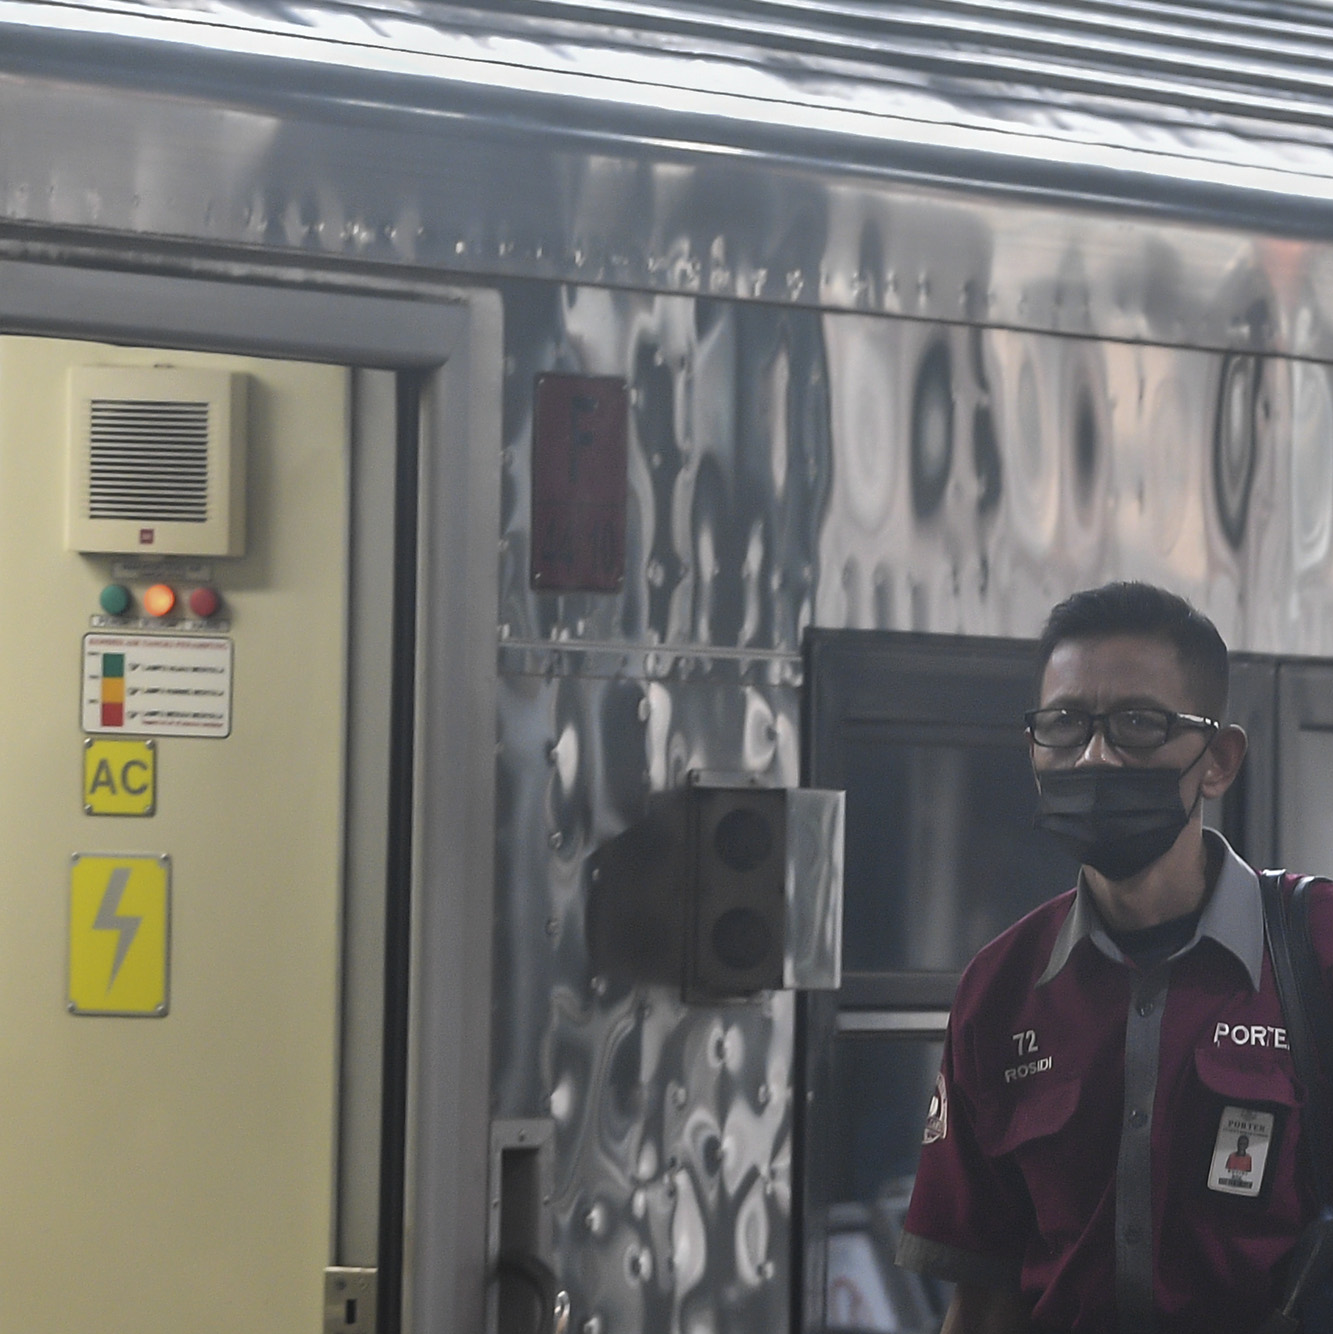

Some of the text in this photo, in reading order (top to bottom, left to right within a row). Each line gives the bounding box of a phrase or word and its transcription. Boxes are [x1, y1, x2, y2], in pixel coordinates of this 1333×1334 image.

[89, 758, 149, 796] AC
[1012, 1029, 1039, 1056] 72
[1213, 1022, 1290, 1051] PORTE
[1004, 1055, 1053, 1083] ROSIDI
[1227, 1120, 1266, 1133] PORTER
